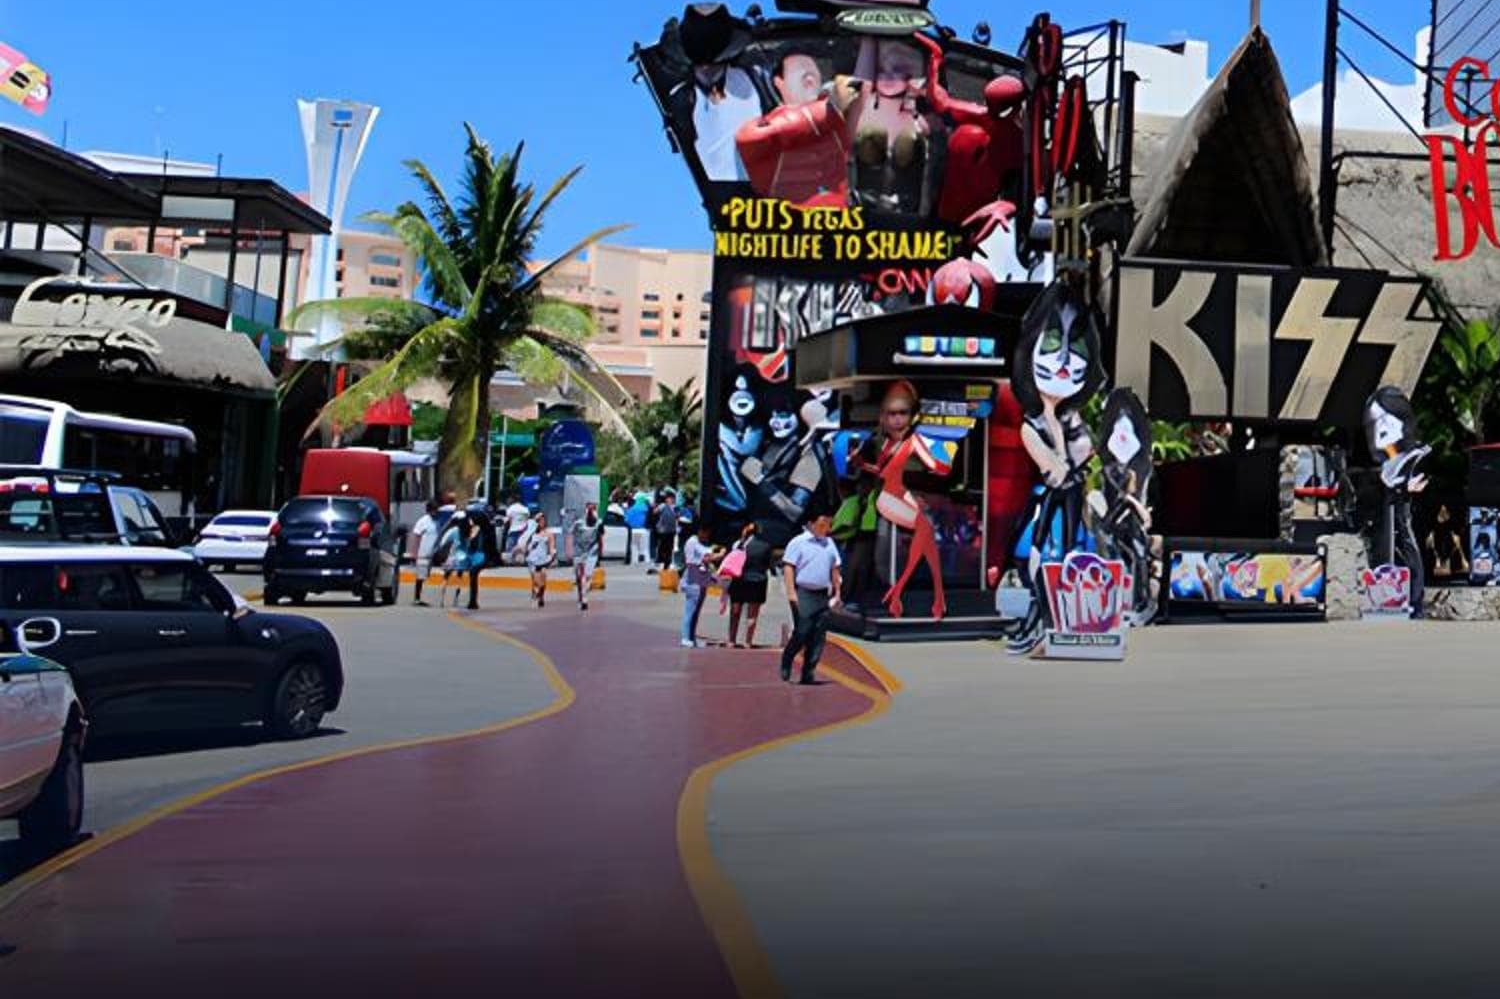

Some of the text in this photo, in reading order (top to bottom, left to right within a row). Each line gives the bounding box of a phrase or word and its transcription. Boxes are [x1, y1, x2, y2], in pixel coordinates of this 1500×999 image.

[715, 233, 823, 258] NIGHTLIFE
[834, 234, 860, 259] TO
[1115, 266, 1446, 421] KISS
